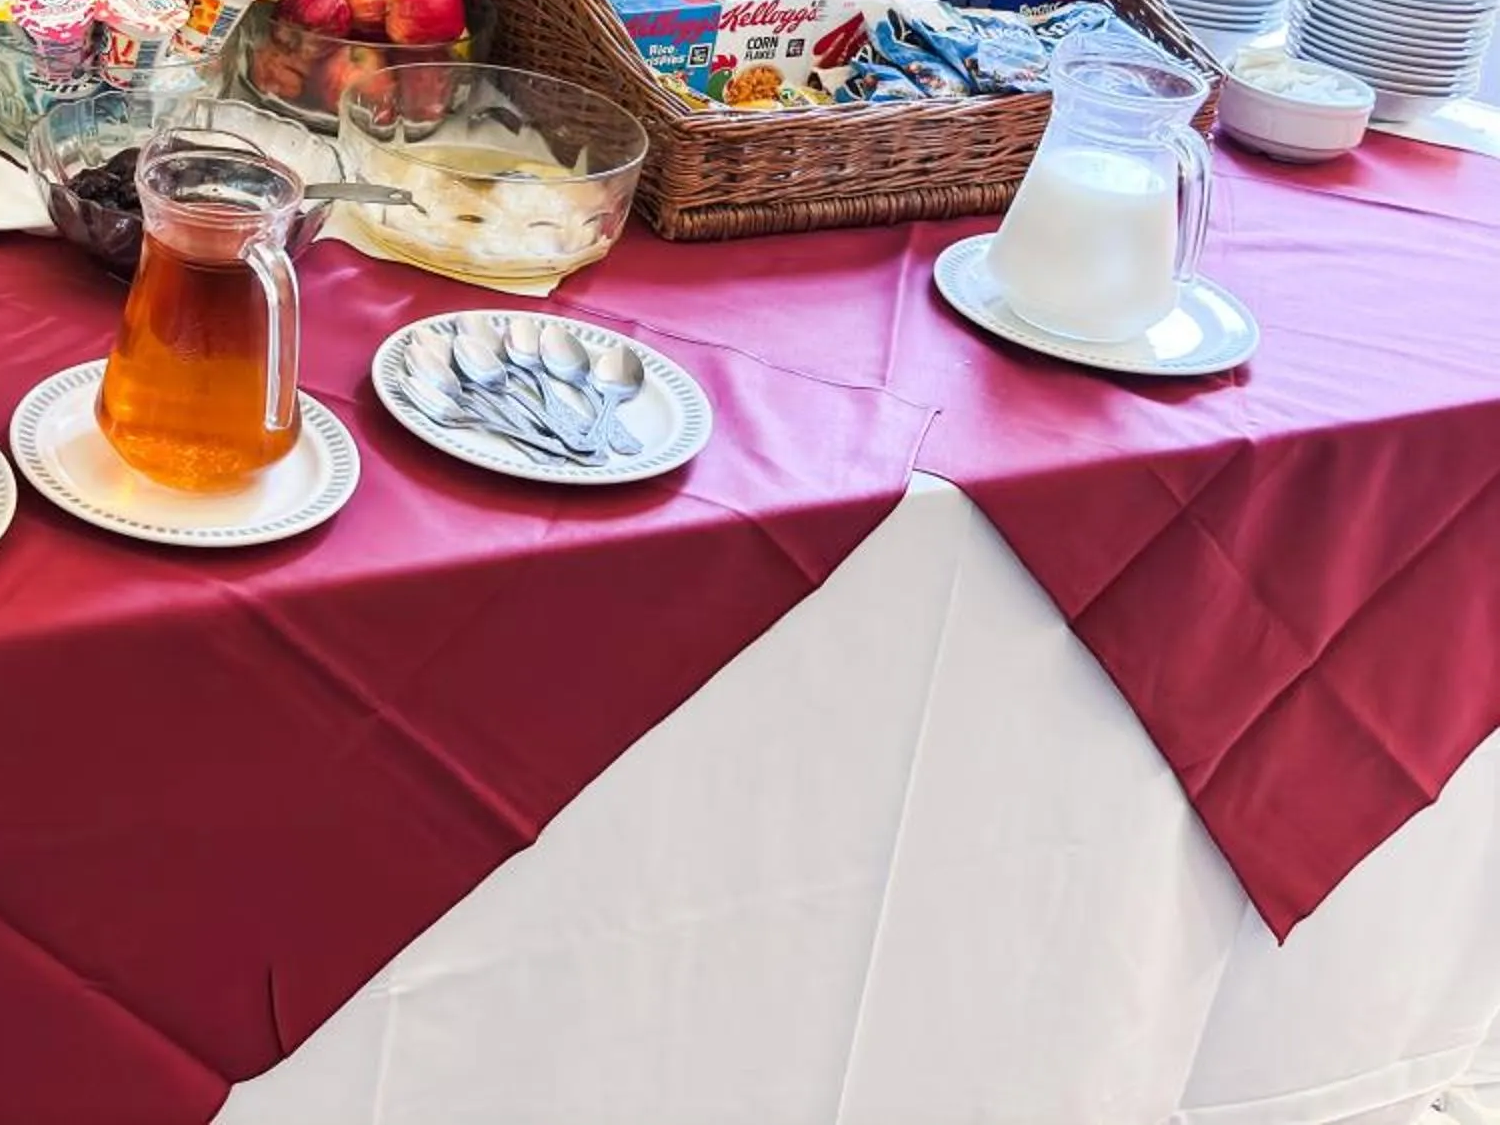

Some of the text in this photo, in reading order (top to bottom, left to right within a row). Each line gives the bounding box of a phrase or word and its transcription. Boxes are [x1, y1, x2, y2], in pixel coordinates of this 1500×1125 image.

[718, 0, 818, 34] Kellogg's
[747, 36, 779, 49] CORN
[649, 44, 676, 55] Rice
[744, 50, 776, 60] FLAKES
